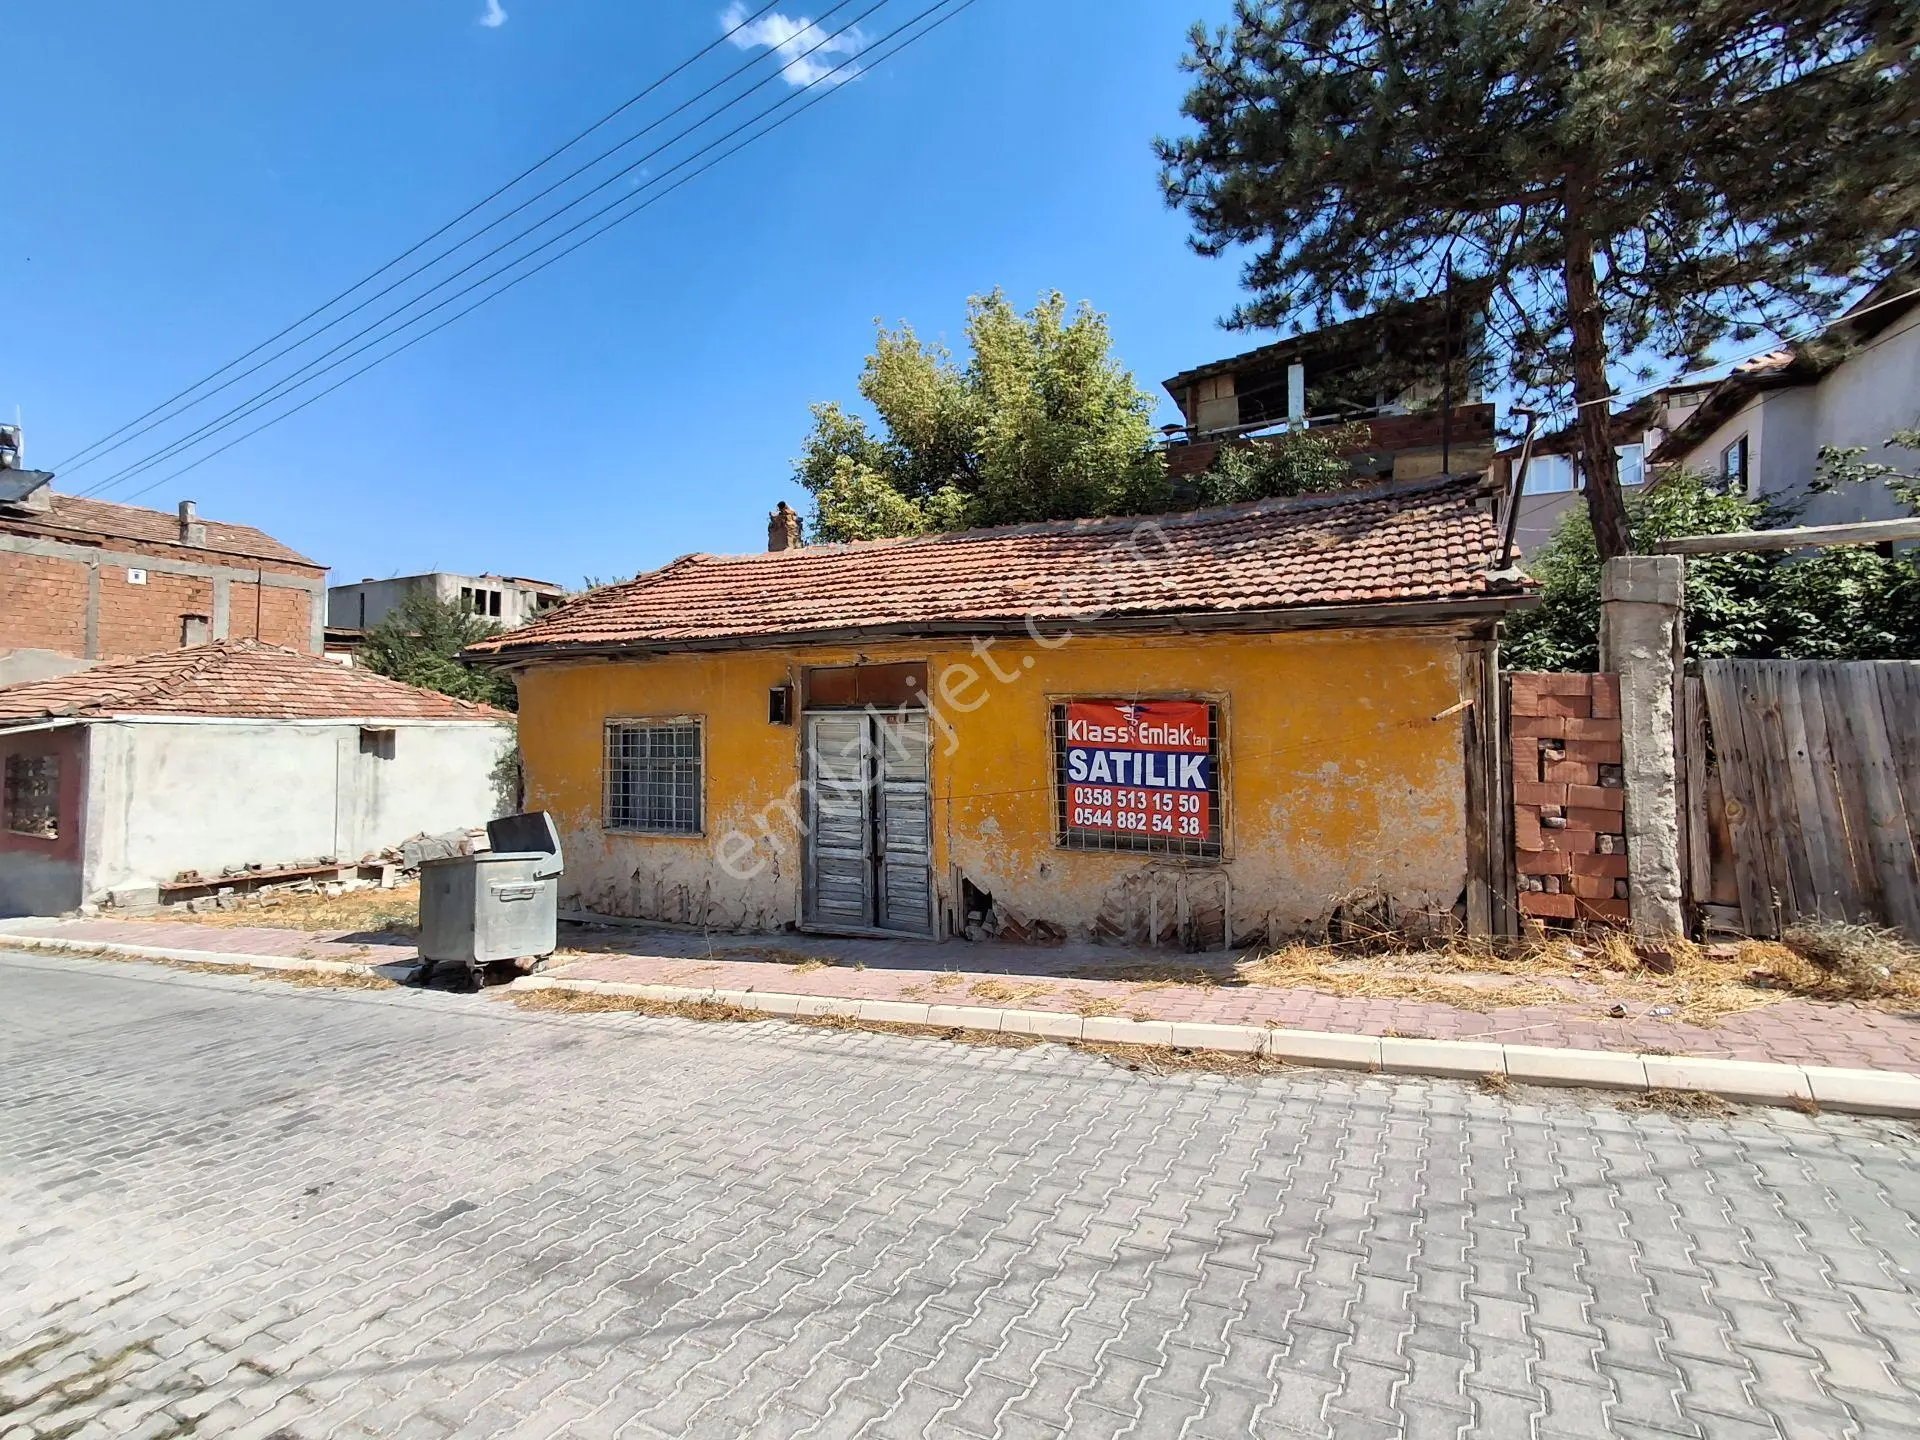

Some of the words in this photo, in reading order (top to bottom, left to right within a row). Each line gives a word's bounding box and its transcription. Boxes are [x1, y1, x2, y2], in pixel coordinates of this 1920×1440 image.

[1067, 719, 1129, 744] Klass
[1068, 749, 1207, 789] SATILIK
[1074, 787, 1112, 807] 0358
[1117, 790, 1147, 809] 513
[1152, 793, 1173, 811] 15
[1178, 795, 1200, 813] 50
[1074, 807, 1113, 827] 0544
[1117, 811, 1147, 830] 882
[1152, 814, 1173, 833] 54
[1178, 816, 1200, 835] 38
